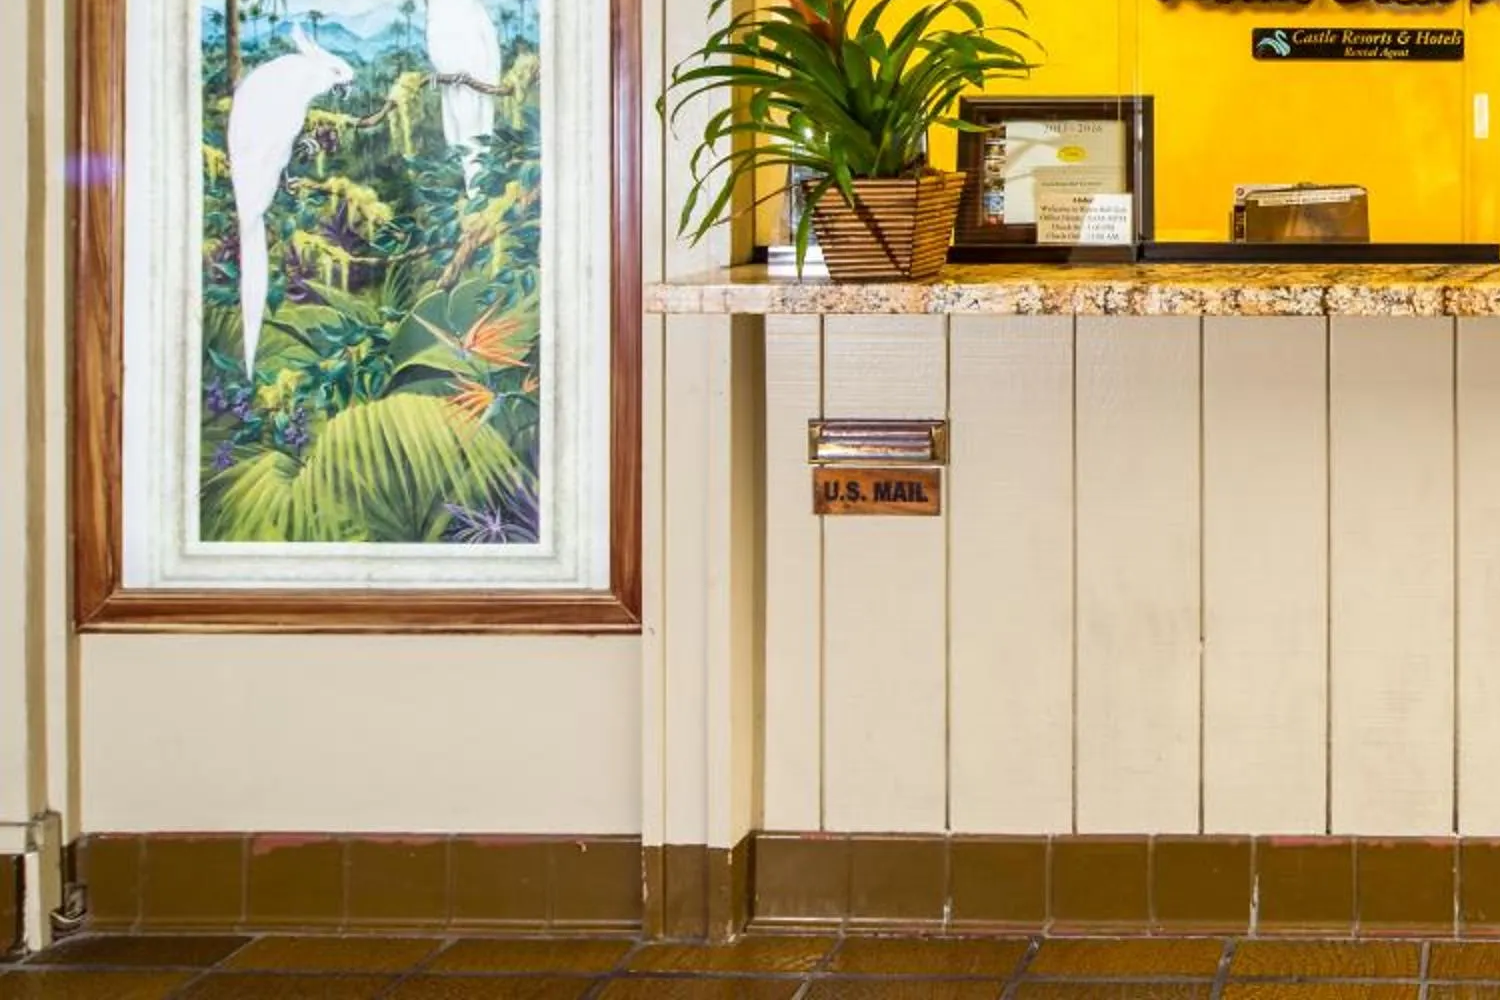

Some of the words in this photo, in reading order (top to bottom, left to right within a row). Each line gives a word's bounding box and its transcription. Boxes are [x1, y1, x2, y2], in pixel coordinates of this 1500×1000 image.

[1292, 30, 1338, 45] Castle
[1341, 30, 1393, 45] Resorts
[1397, 31, 1412, 45] &
[1415, 31, 1462, 45] Hotels
[824, 480, 867, 502] U.S.
[873, 480, 929, 502] MAIL
